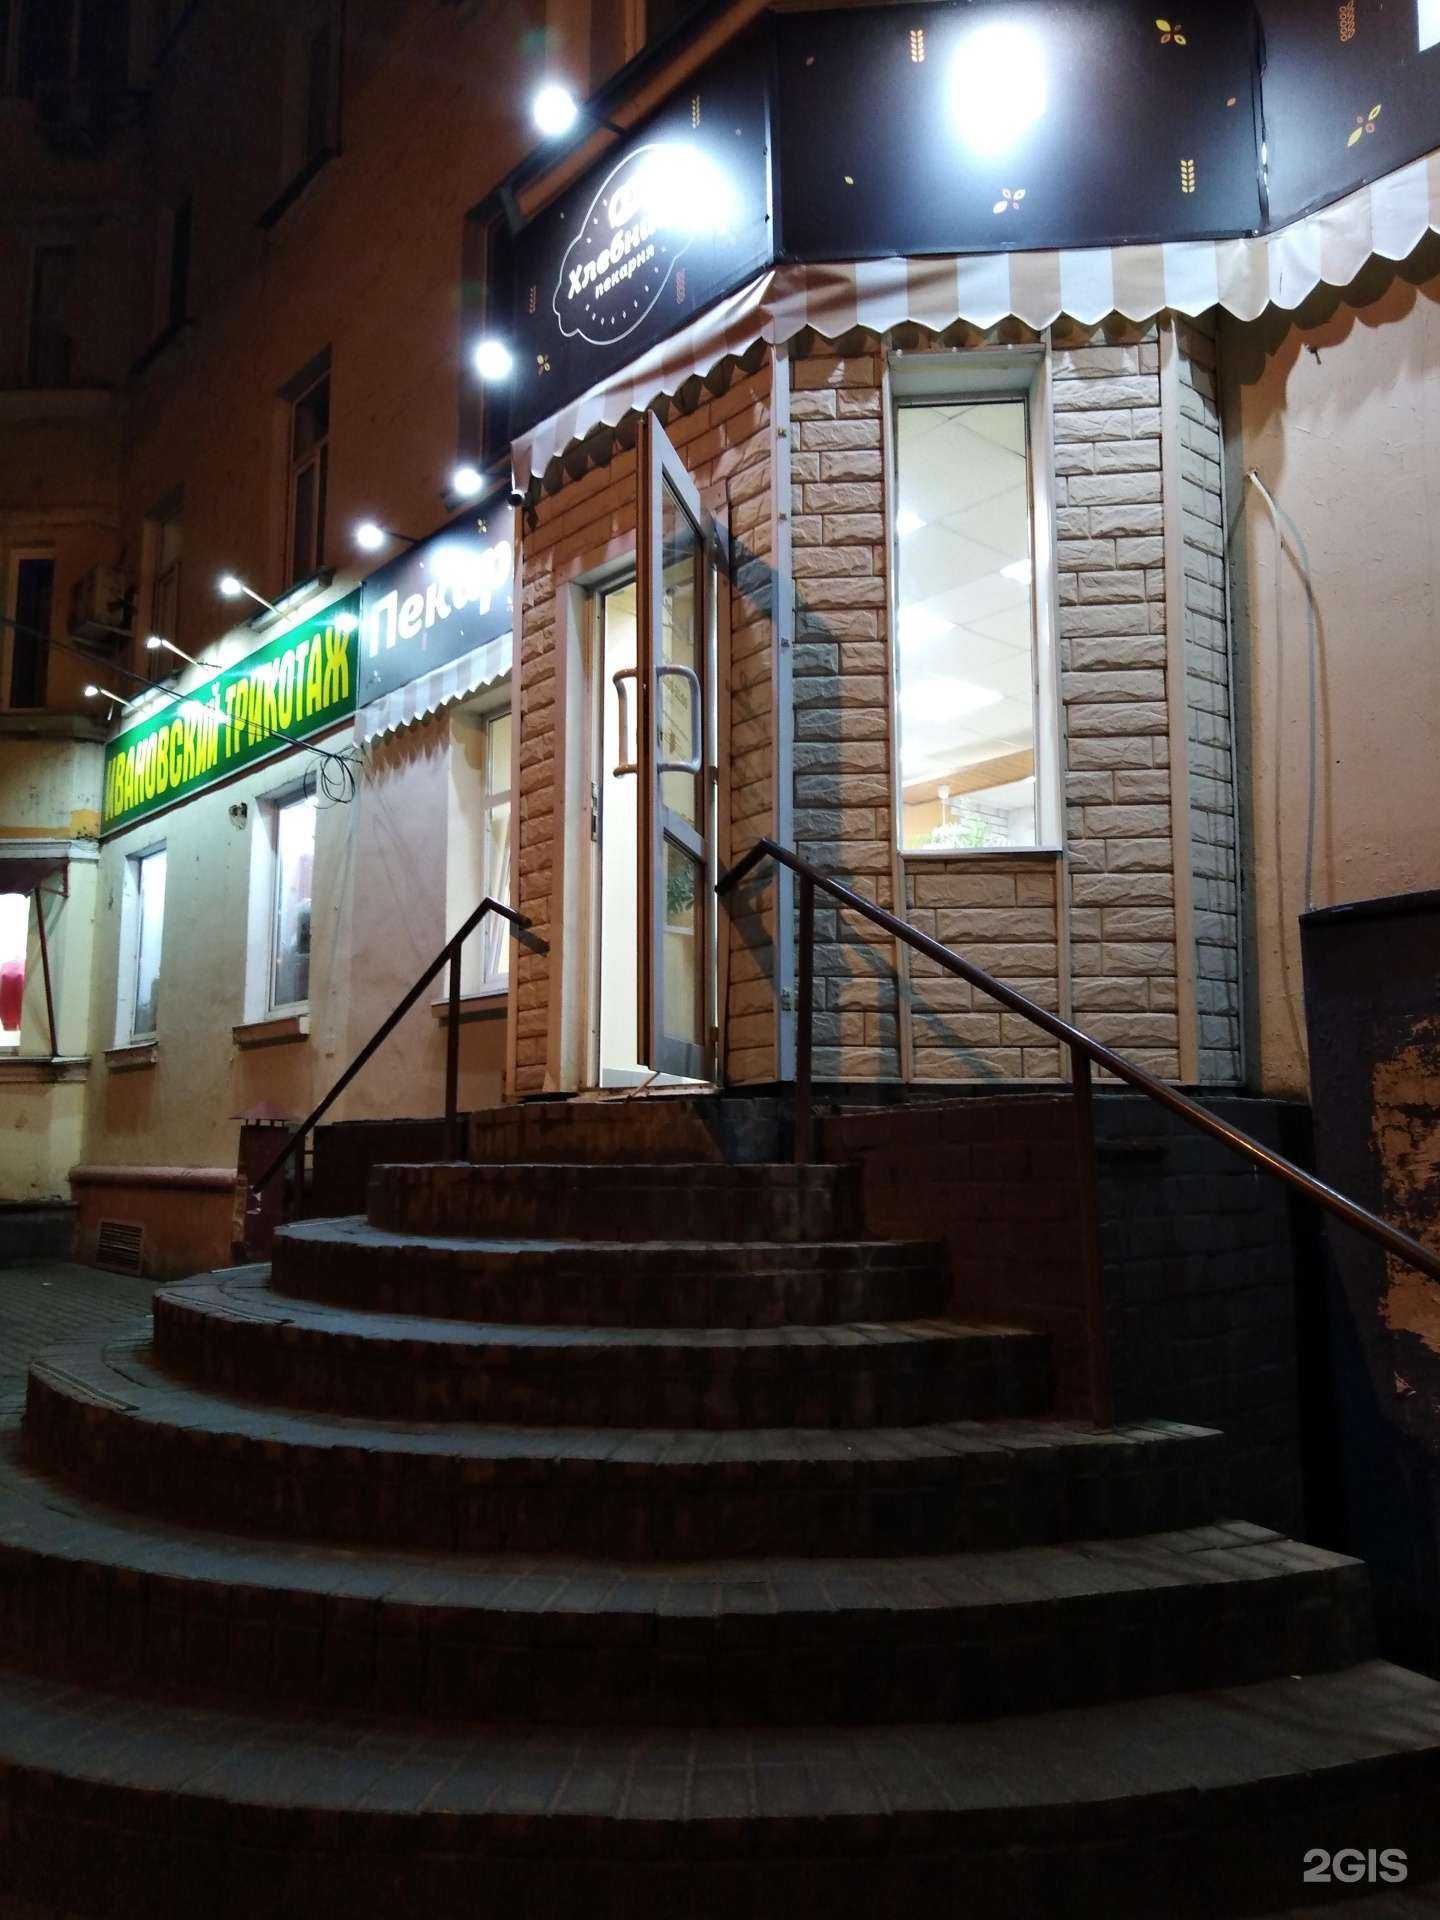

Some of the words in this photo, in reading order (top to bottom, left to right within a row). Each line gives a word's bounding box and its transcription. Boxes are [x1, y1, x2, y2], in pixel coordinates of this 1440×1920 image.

[595, 244, 655, 300] пекарня
[104, 681, 218, 821] ИВАНОВСКИЙ
[225, 625, 350, 759] ТРИКОТАЖ
